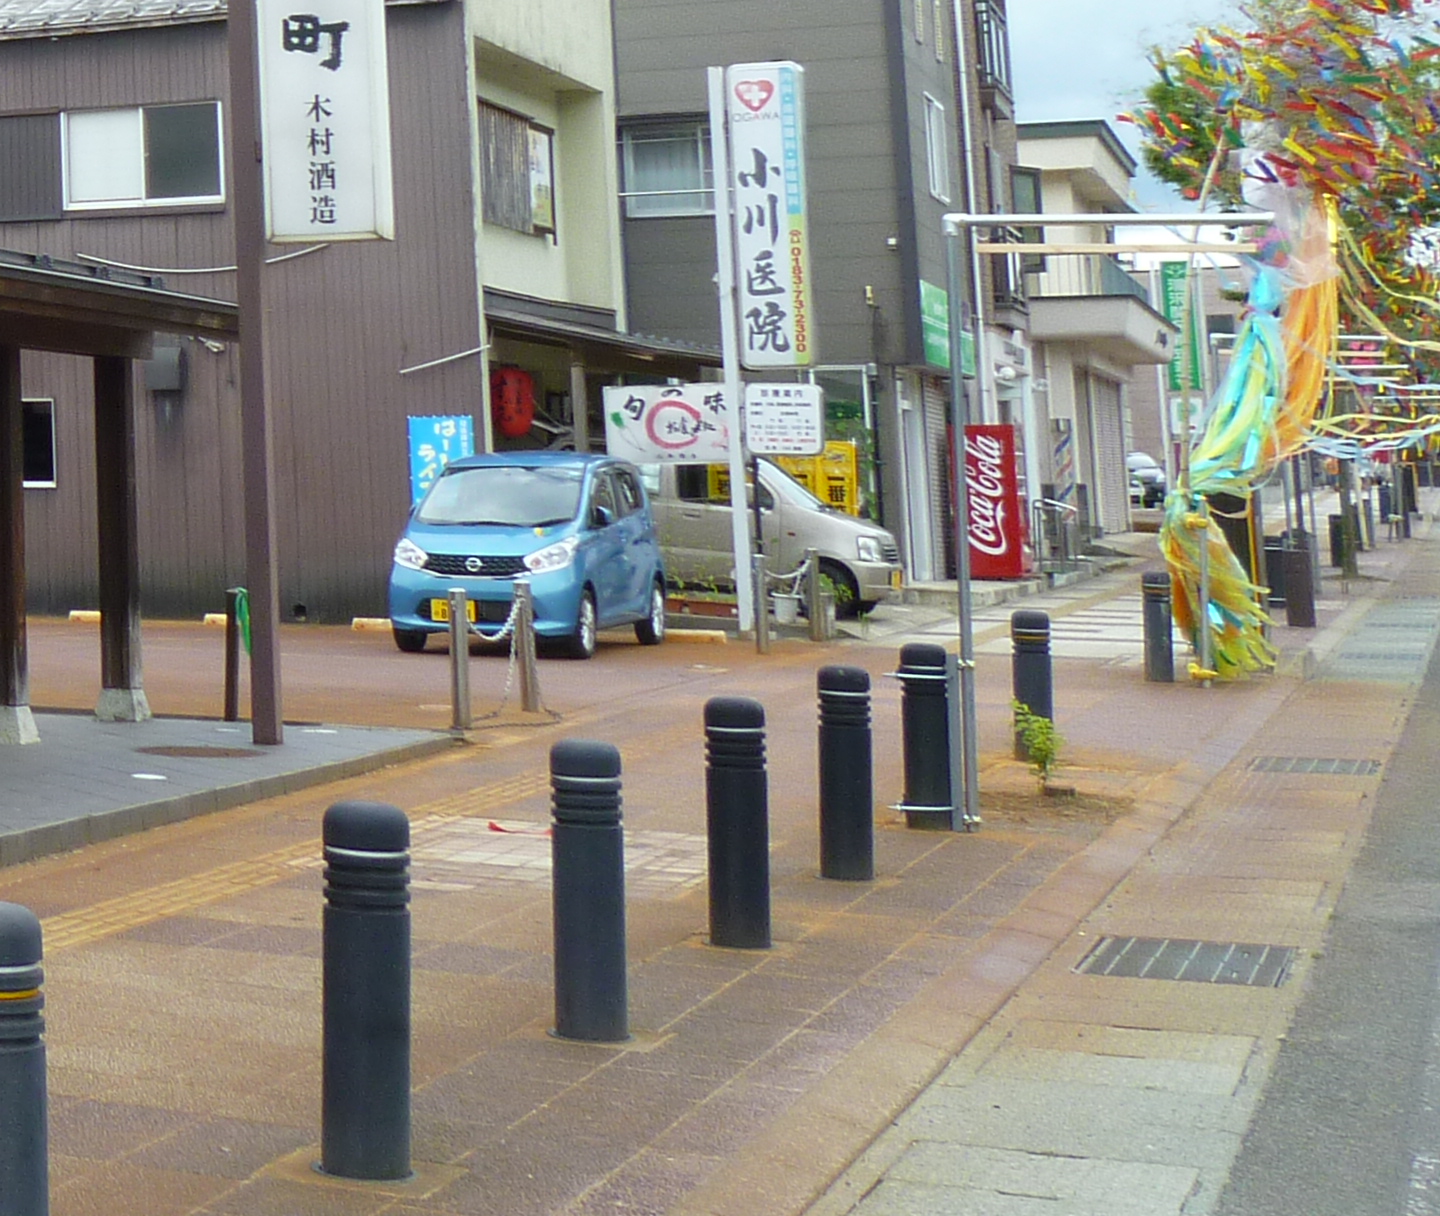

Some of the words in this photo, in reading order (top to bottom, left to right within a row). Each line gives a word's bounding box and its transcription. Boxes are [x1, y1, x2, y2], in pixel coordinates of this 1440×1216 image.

[732, 111, 780, 123] OGAWA
[304, 94, 337, 224] 木村酒造
[737, 148, 791, 352] 小川医院
[623, 388, 728, 421] 旬の味
